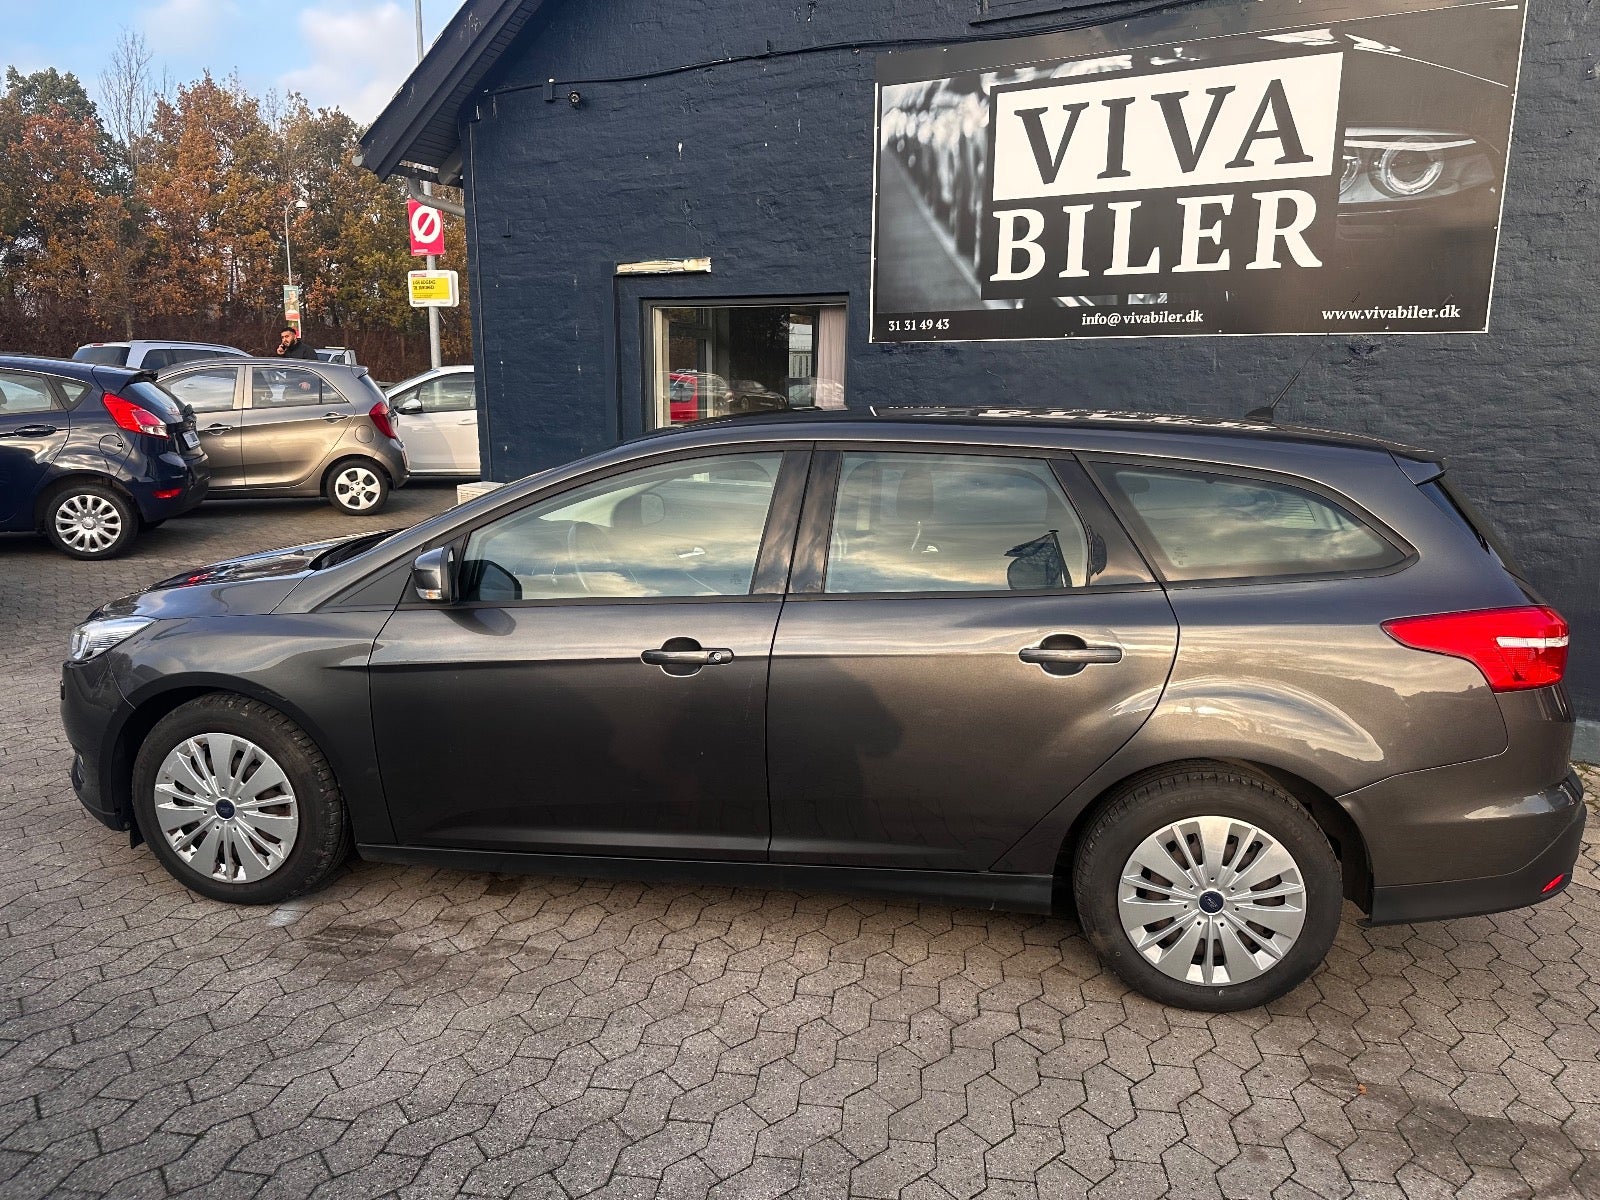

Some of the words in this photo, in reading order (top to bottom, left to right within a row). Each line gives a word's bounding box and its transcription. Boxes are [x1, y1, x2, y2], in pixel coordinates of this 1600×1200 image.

[1013, 78, 1314, 185] VIVA
[989, 189, 1323, 282] BILER
[1081, 309, 1204, 327] info@vivabiler.dk
[1321, 304, 1461, 320] www.vivabiler.dk
[888, 320, 901, 331] 31
[904, 319, 917, 331] 31
[919, 318, 934, 330] 49
[935, 318, 950, 330] 43
